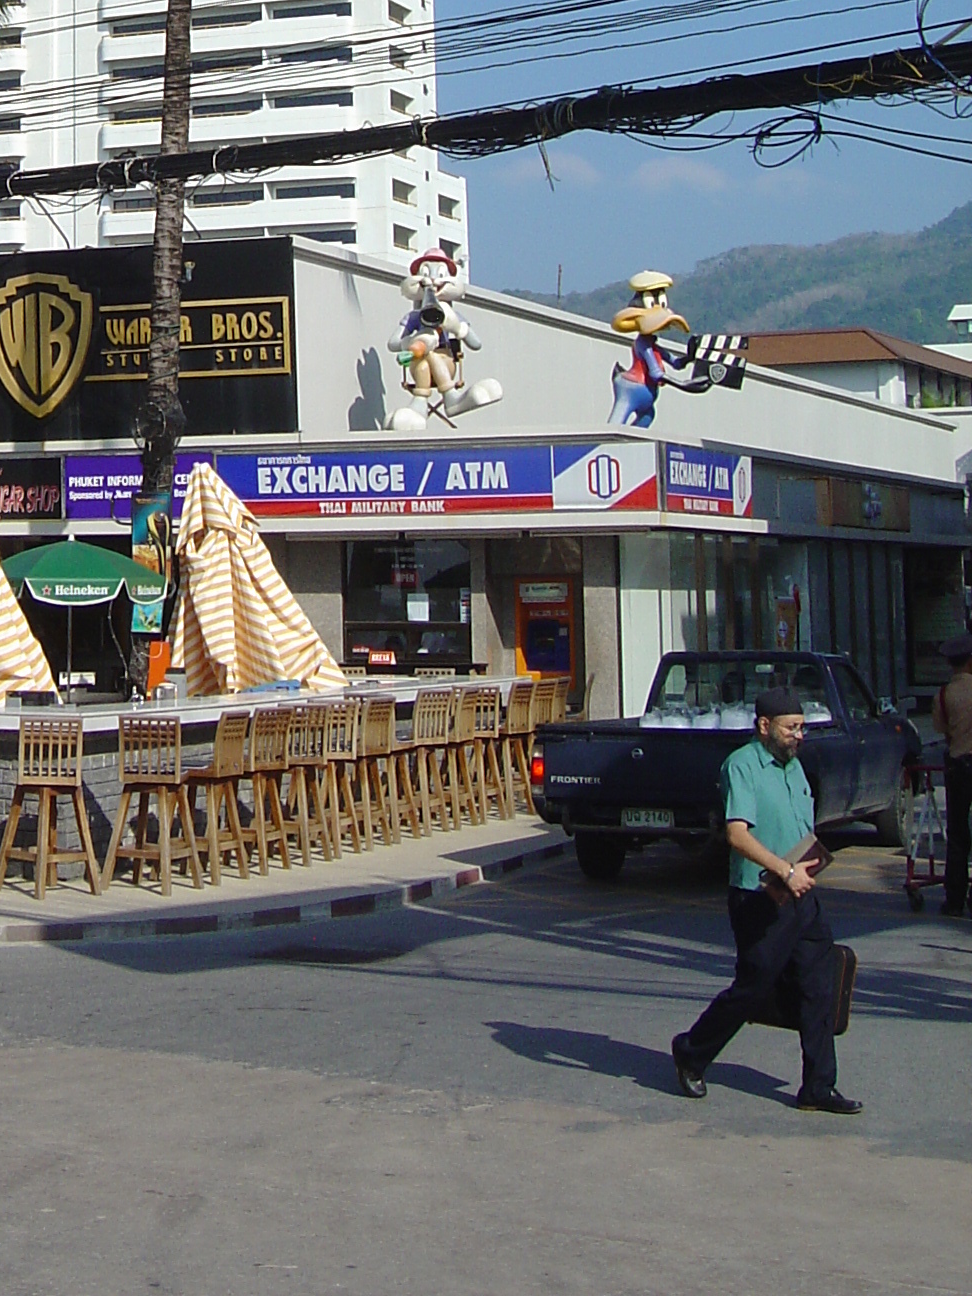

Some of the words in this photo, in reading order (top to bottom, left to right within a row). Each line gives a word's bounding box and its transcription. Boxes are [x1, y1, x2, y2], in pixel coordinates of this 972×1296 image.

[105, 313, 193, 346] WARR
[211, 311, 283, 342] BROS.
[0, 292, 76, 397] WB
[215, 345, 283, 363] STORE
[68, 475, 104, 488] PHUKET
[106, 475, 144, 487] INFORM
[257, 464, 405, 495] EXCHANGE
[416, 461, 434, 496] /
[444, 461, 509, 491] ATM
[669, 460, 707, 488] EXCHANGE
[26, 484, 60, 514] SHOP
[68, 490, 104, 501] Sponsored
[104, 490, 114, 501] by
[319, 501, 346, 514] THAI
[351, 500, 406, 514] MILITARY
[410, 499, 445, 513] BANK
[54, 584, 111, 596] Heineken
[550, 774, 602, 785] FRONTIER
[644, 810, 670, 823] 2140
